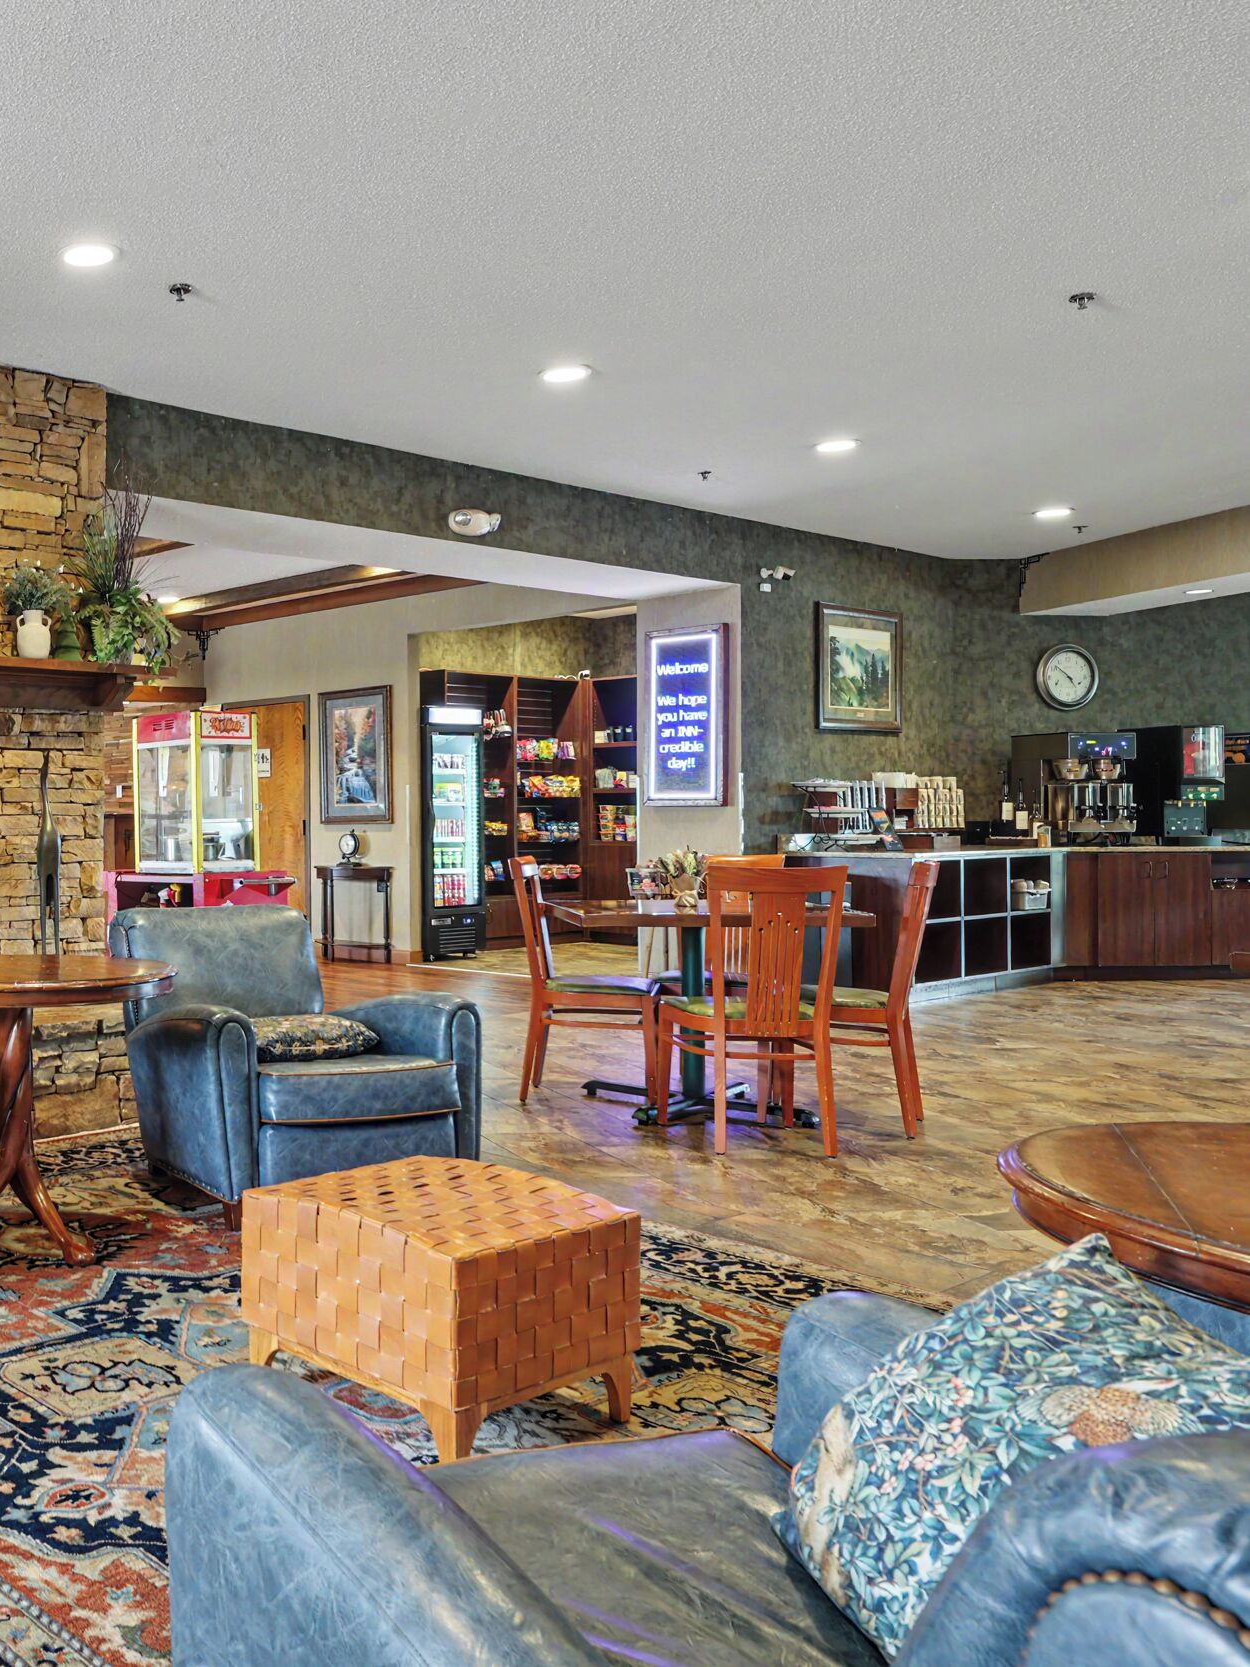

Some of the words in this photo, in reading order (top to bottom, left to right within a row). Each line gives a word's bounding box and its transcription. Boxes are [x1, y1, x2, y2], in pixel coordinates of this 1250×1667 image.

[657, 662, 709, 676] Welcome
[657, 696, 676, 706] We
[678, 693, 707, 707] hope
[657, 712, 677, 725] you
[678, 710, 707, 721] have
[661, 728, 675, 738] an
[677, 726, 704, 737] INN-
[659, 741, 704, 753] credible
[667, 757, 696, 771] day!!
